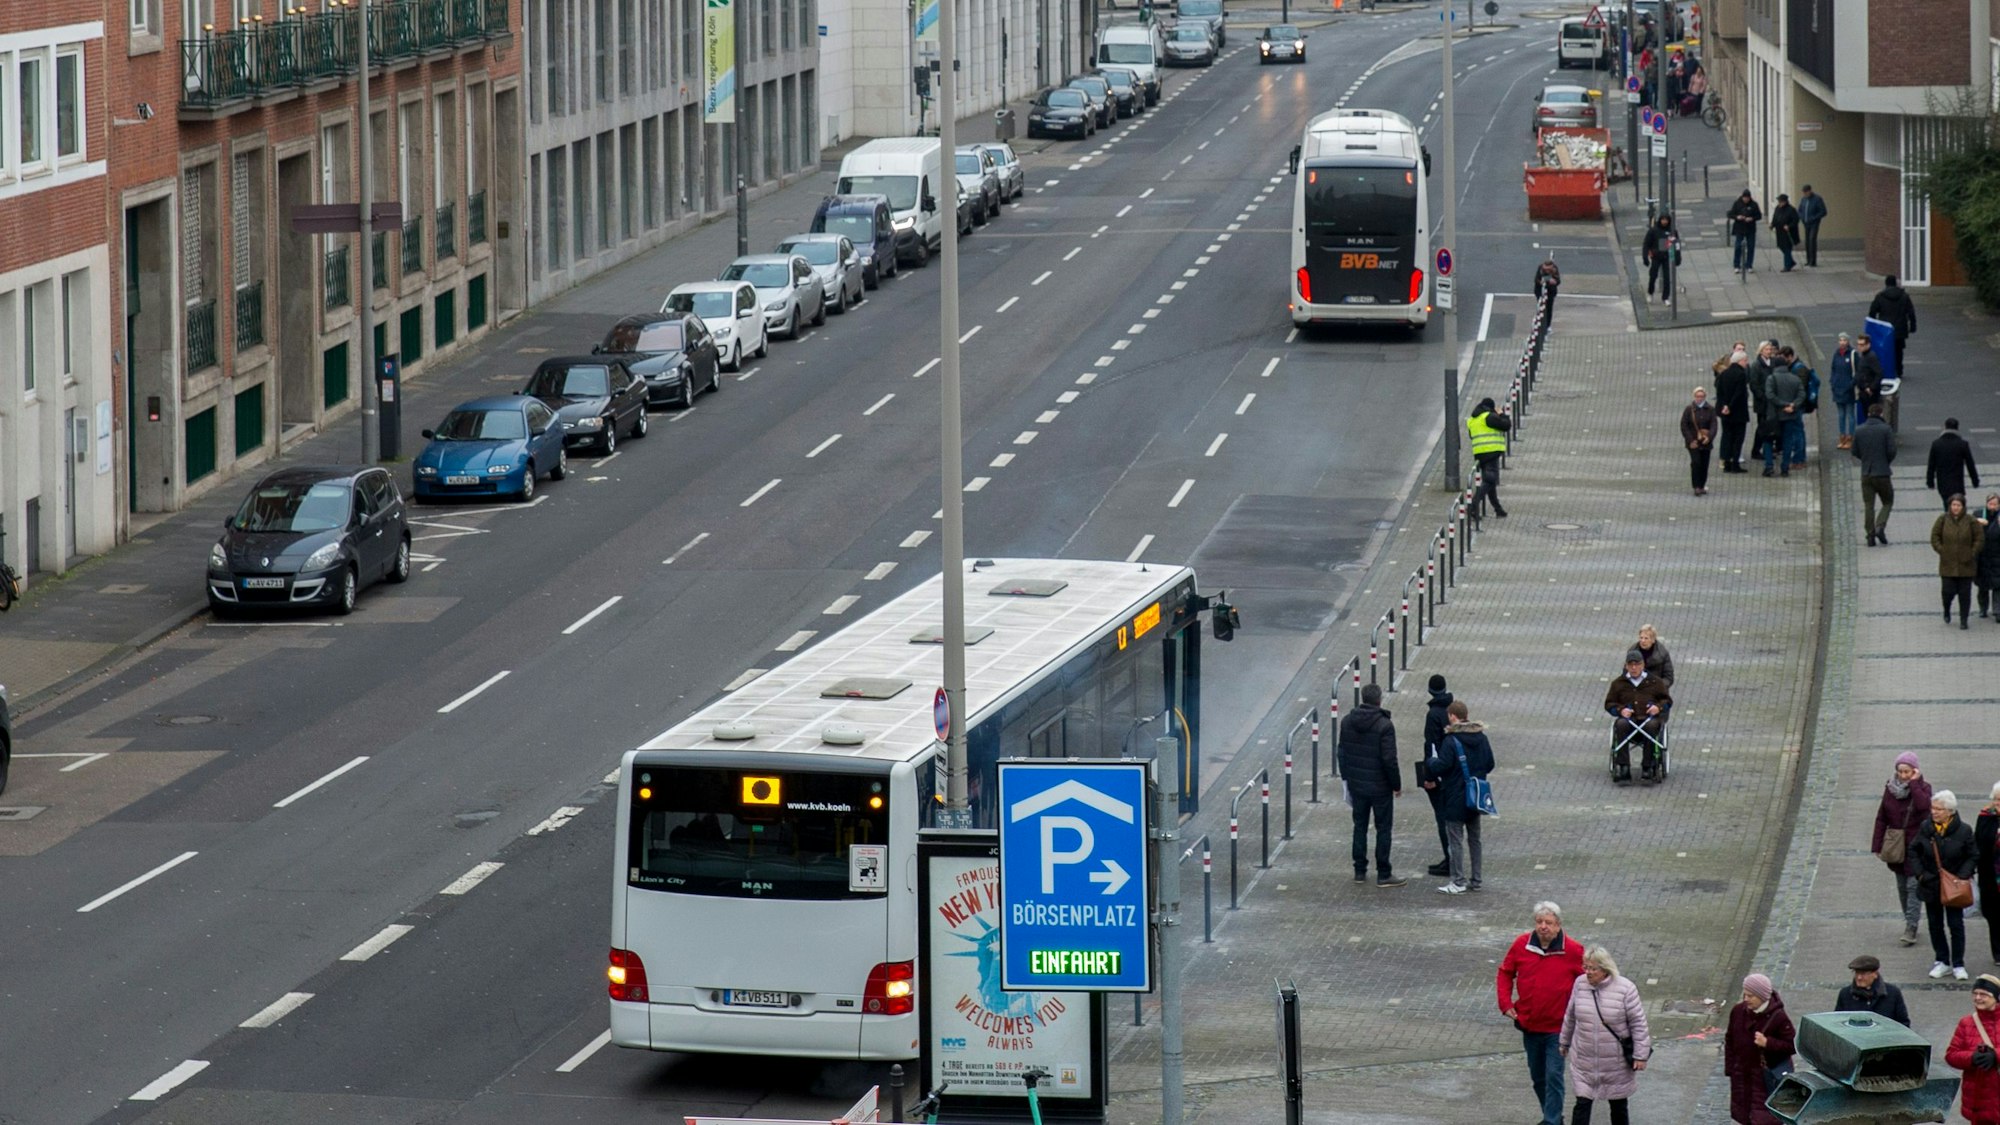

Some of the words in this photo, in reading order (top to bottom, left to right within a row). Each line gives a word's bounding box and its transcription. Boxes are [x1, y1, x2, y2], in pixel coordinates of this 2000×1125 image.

[708, 15, 716, 36] Köln
[708, 38, 718, 114] Bezirksregierung
[787, 801, 851, 812] www.kvb.koeln
[1040, 815, 1094, 894] P
[667, 876, 686, 885] City
[742, 881, 773, 890] MAN
[955, 866, 999, 888] FAMOUS
[938, 886, 983, 929] NEW
[1013, 899, 1136, 927] BÖRSENPLATZ
[1031, 950, 1121, 975] EINFAHRT
[733, 991, 741, 1002] K
[955, 994, 1034, 1035] WELCOMES
[1034, 997, 1066, 1027] YOU
[941, 1037, 966, 1047] NYC
[987, 1035, 1033, 1051] ALWAYS
[948, 1060, 963, 1070] TAGE
